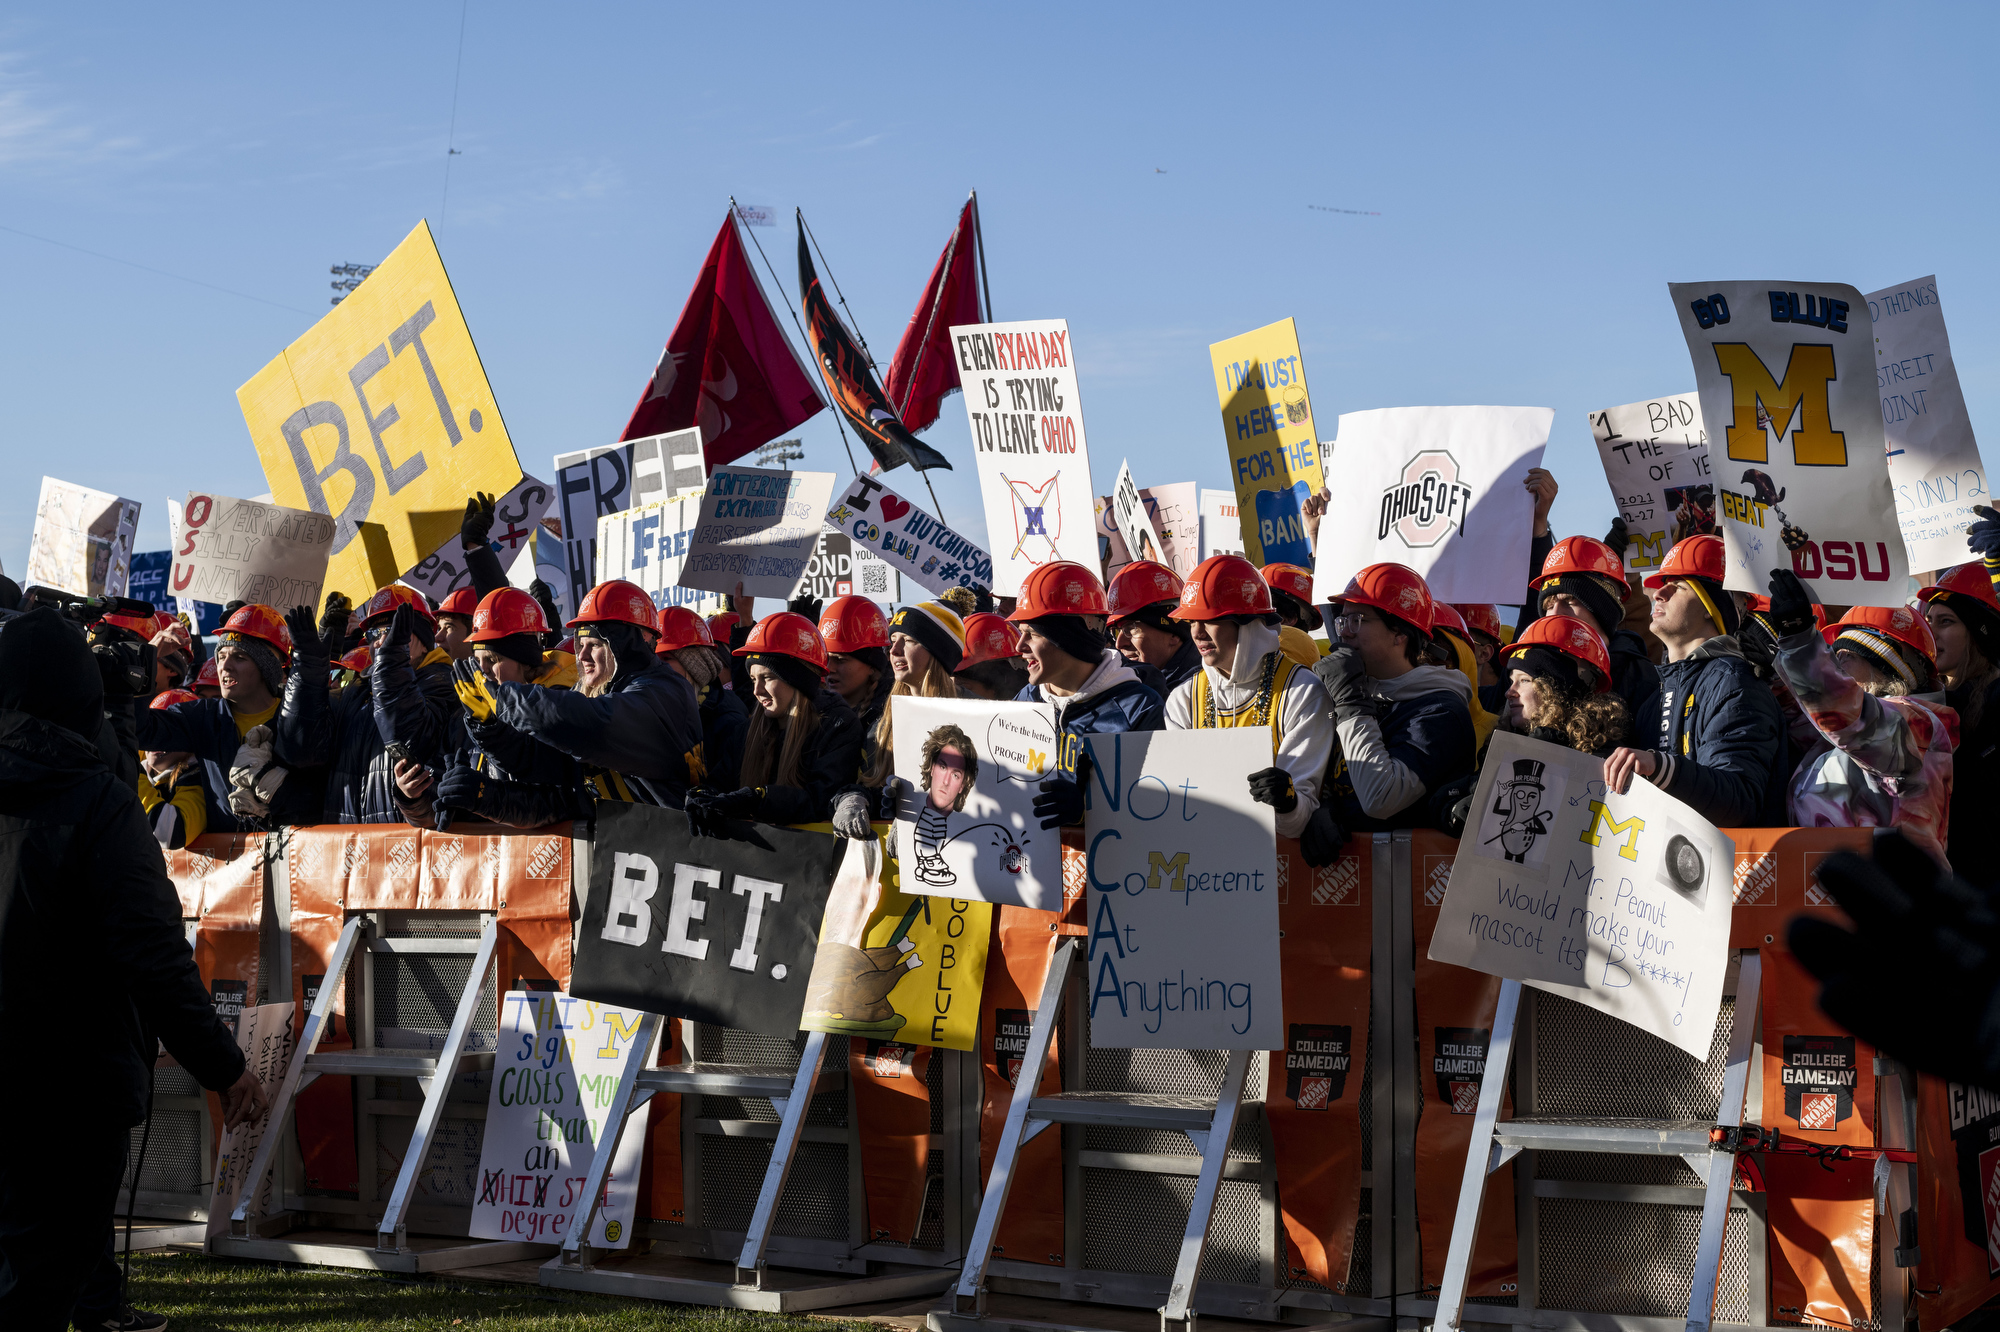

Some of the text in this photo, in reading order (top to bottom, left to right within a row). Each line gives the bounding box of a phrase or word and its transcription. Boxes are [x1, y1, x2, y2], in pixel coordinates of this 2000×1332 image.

[1691, 291, 1850, 334] GO BLUE
[1881, 283, 1939, 317] THINGS
[956, 330, 1068, 372] EVEN RYAN DAY
[1223, 354, 1299, 392] I'M JUST
[1876, 353, 1935, 388] STREIT
[982, 376, 1064, 412] IS TRYING
[1711, 341, 1849, 467] M
[1882, 389, 1928, 425] OINT
[280, 299, 484, 556] BET.
[972, 412, 1076, 455] TO LEAVE OHIO
[1235, 401, 1286, 441] HERE
[1647, 400, 1694, 434] BAD
[1236, 449, 1276, 486] FOR
[1275, 438, 1315, 474] THE
[1612, 429, 1709, 465] THE LA
[711, 472, 802, 499] INTERNET
[1649, 461, 1674, 481] OF
[1916, 469, 1986, 509] ONLY 2
[1619, 493, 1655, 506] 2021
[1719, 488, 1769, 529] BEAT
[185, 494, 333, 545] OVERRATED
[697, 524, 762, 547] FASTER
[768, 526, 806, 549] THAN
[845, 474, 993, 584] I HUTCHINSON
[1904, 527, 1949, 542] ICHIGAN
[180, 529, 261, 562] SILLY
[852, 519, 921, 565] GO BLUE!
[1790, 540, 1891, 582] OSU
[173, 562, 324, 610] UNIVERSITY
[799, 576, 838, 599] GUY
[998, 718, 1053, 745] We're the better
[1658, 691, 1674, 750] MICH
[1083, 733, 1199, 822] Not
[384, 837, 417, 878] HOME
[431, 837, 464, 878] HOME
[526, 836, 562, 879] HOME
[531, 840, 545, 858] THE
[539, 851, 562, 879] DEPOT
[1312, 855, 1358, 905] HOME
[1316, 862, 1335, 880] THE
[1428, 860, 1448, 878] THE
[1733, 858, 1752, 880] THE
[1733, 852, 1777, 906] HOME
[1330, 874, 1358, 905] DEPOT
[1563, 859, 1667, 929] Mr. Peanut
[1744, 871, 1777, 905] DEPOT
[600, 850, 789, 982] BET.
[1088, 893, 1140, 962] At
[1498, 877, 1675, 960] Would make your
[1468, 911, 1544, 955] mascot
[1558, 936, 1587, 972] its
[215, 992, 243, 1002] COLLEGE
[930, 943, 957, 1043] BLUE
[1090, 951, 1252, 1036] Anything
[505, 996, 600, 1033] THIS
[1002, 1024, 1034, 1036] COLLE
[278, 1010, 296, 1082] WHAT
[516, 1032, 577, 1070] sign
[1286, 1054, 1350, 1071] GAMEDAY
[1296, 1040, 1343, 1053] COLLEGE
[1442, 1043, 1483, 1057] COLLEGE
[1792, 1053, 1847, 1067] COLLEGE
[1805, 1041, 1834, 1050] ESPN
[499, 1066, 622, 1110] Costs Mo
[1297, 1077, 1331, 1109] HOME
[1303, 1080, 1317, 1094] THE
[1454, 1084, 1465, 1097] THE
[1783, 1068, 1856, 1086] GAMEDAY
[1308, 1089, 1329, 1109] DEPOT
[1453, 1081, 1479, 1113] HOME
[1800, 1093, 1837, 1128] HOME
[1804, 1097, 1820, 1112] THE
[533, 1109, 598, 1145] than
[1813, 1106, 1836, 1129] DEPOT
[524, 1145, 560, 1172] an
[501, 1209, 574, 1242] Degre
